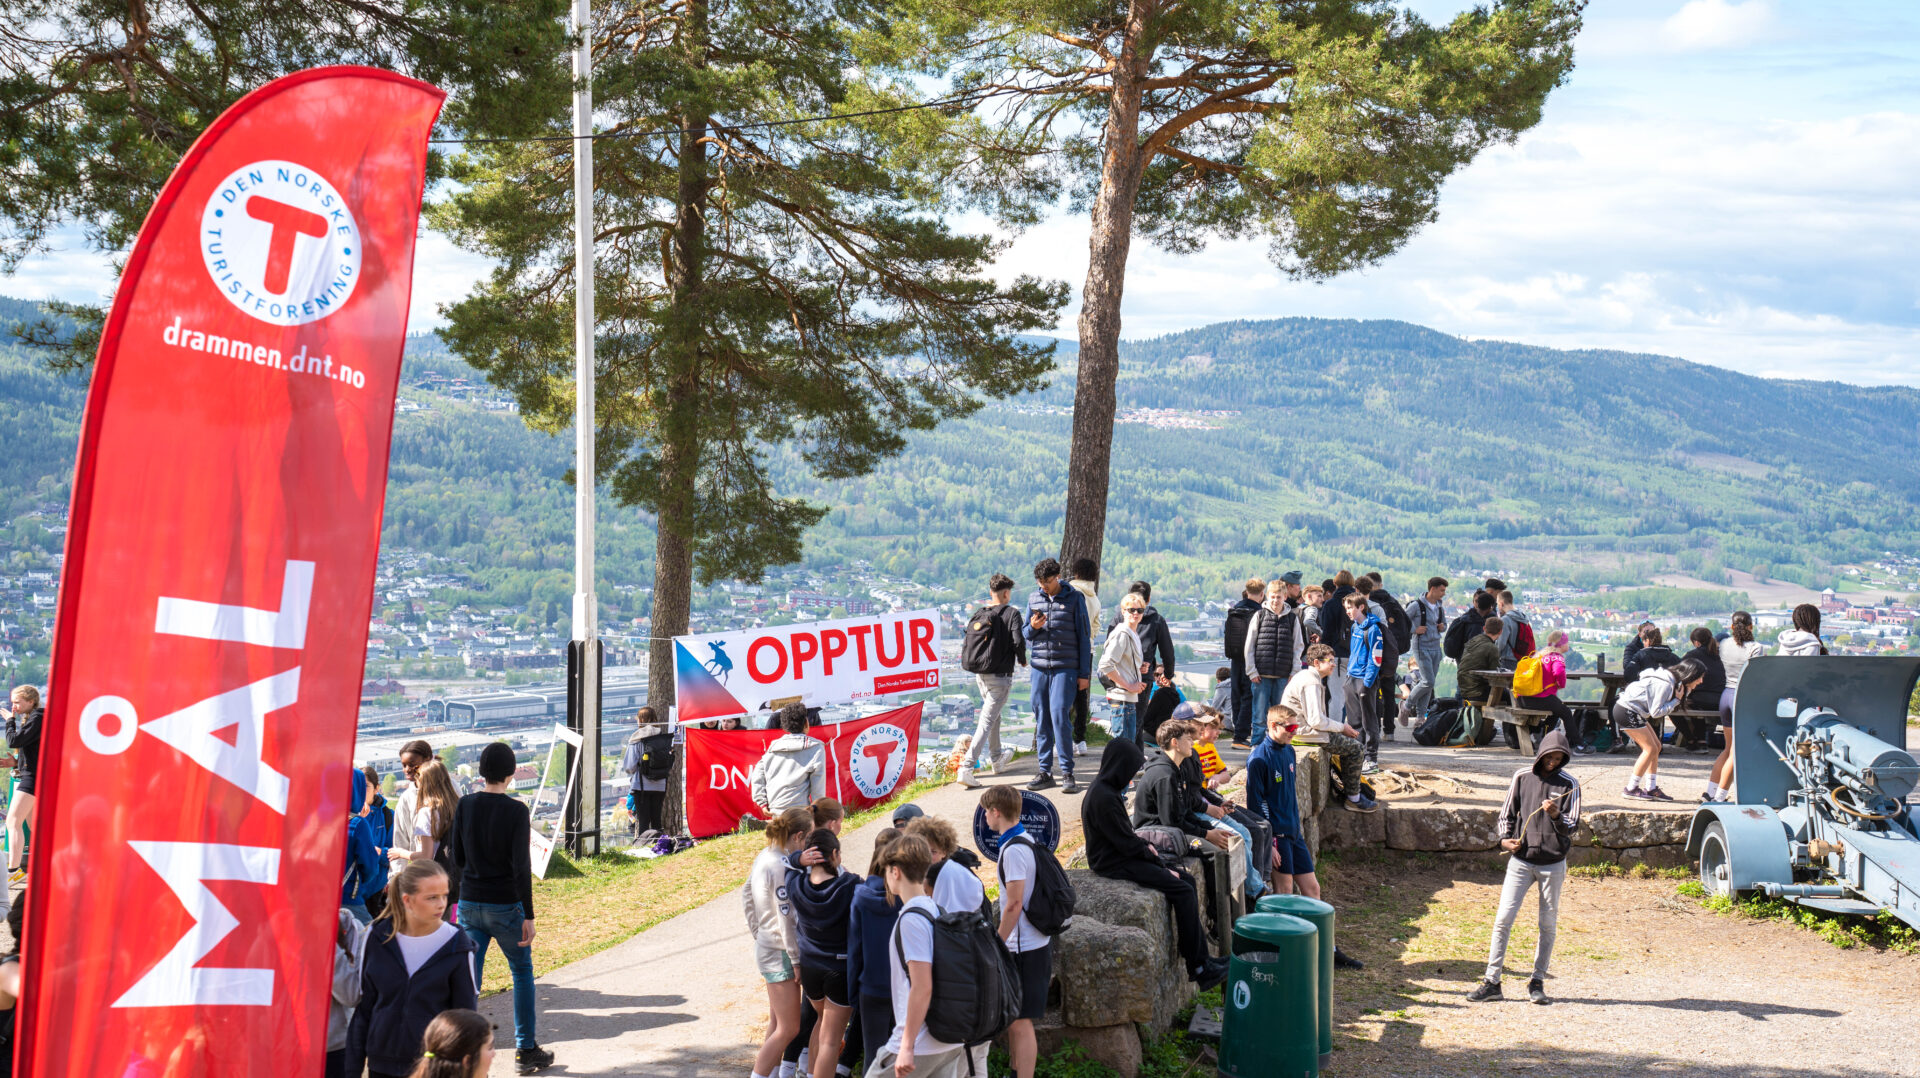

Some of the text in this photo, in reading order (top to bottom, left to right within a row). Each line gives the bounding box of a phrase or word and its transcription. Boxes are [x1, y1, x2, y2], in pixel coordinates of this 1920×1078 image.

[222, 168, 351, 236] DEN NORSKE
[208, 228, 353, 319] TURISTFORENING
[246, 195, 328, 295] T
[163, 316, 366, 389] drammen.dnt.no
[746, 618, 938, 684] OPPTUR
[851, 691, 872, 699] dnt.no
[853, 734, 868, 756] DEN
[79, 559, 316, 1008] MÅL
